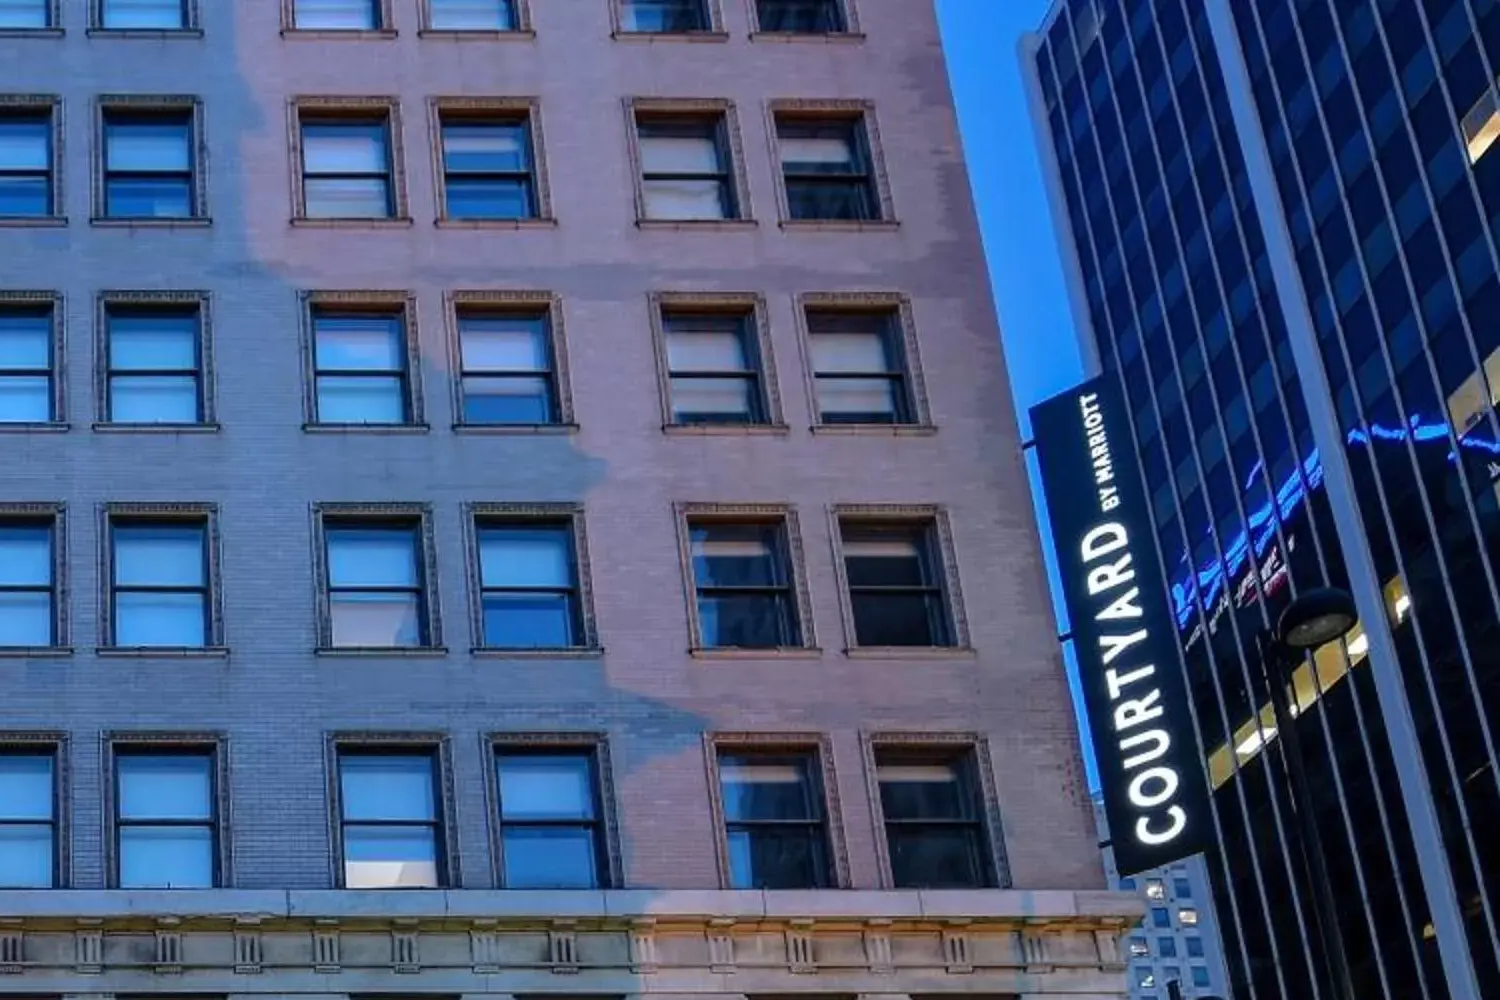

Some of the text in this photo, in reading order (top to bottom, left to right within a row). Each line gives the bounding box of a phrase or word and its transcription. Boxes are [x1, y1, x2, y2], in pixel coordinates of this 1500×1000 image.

[1080, 392, 1187, 846] COURTYARD BY MARRIOTT
